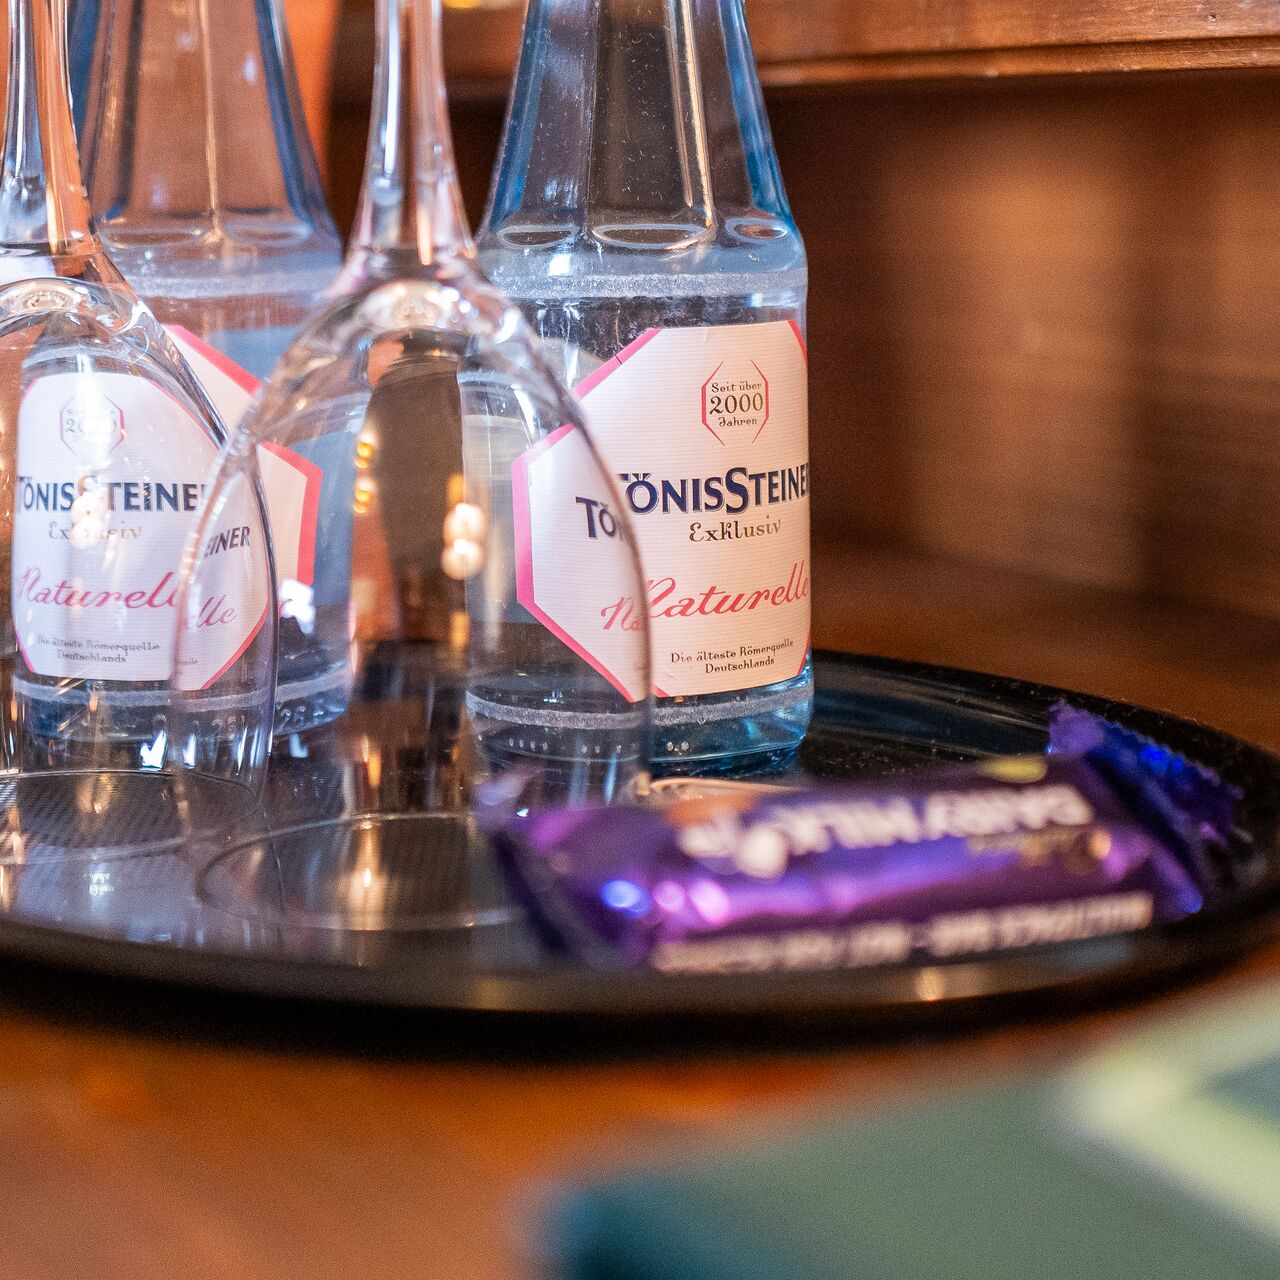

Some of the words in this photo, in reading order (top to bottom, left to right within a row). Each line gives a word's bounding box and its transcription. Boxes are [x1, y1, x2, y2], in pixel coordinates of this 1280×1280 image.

[711, 382, 737, 393] Seit
[739, 381, 762, 391] über
[709, 393, 764, 415] 2000
[718, 416, 758, 428] Jahren
[689, 515, 782, 543] Exklusiv
[671, 652, 693, 664] Die
[696, 649, 738, 662] älteste
[739, 639, 795, 658] Römerquelle
[705, 655, 776, 675] Deutschlands
